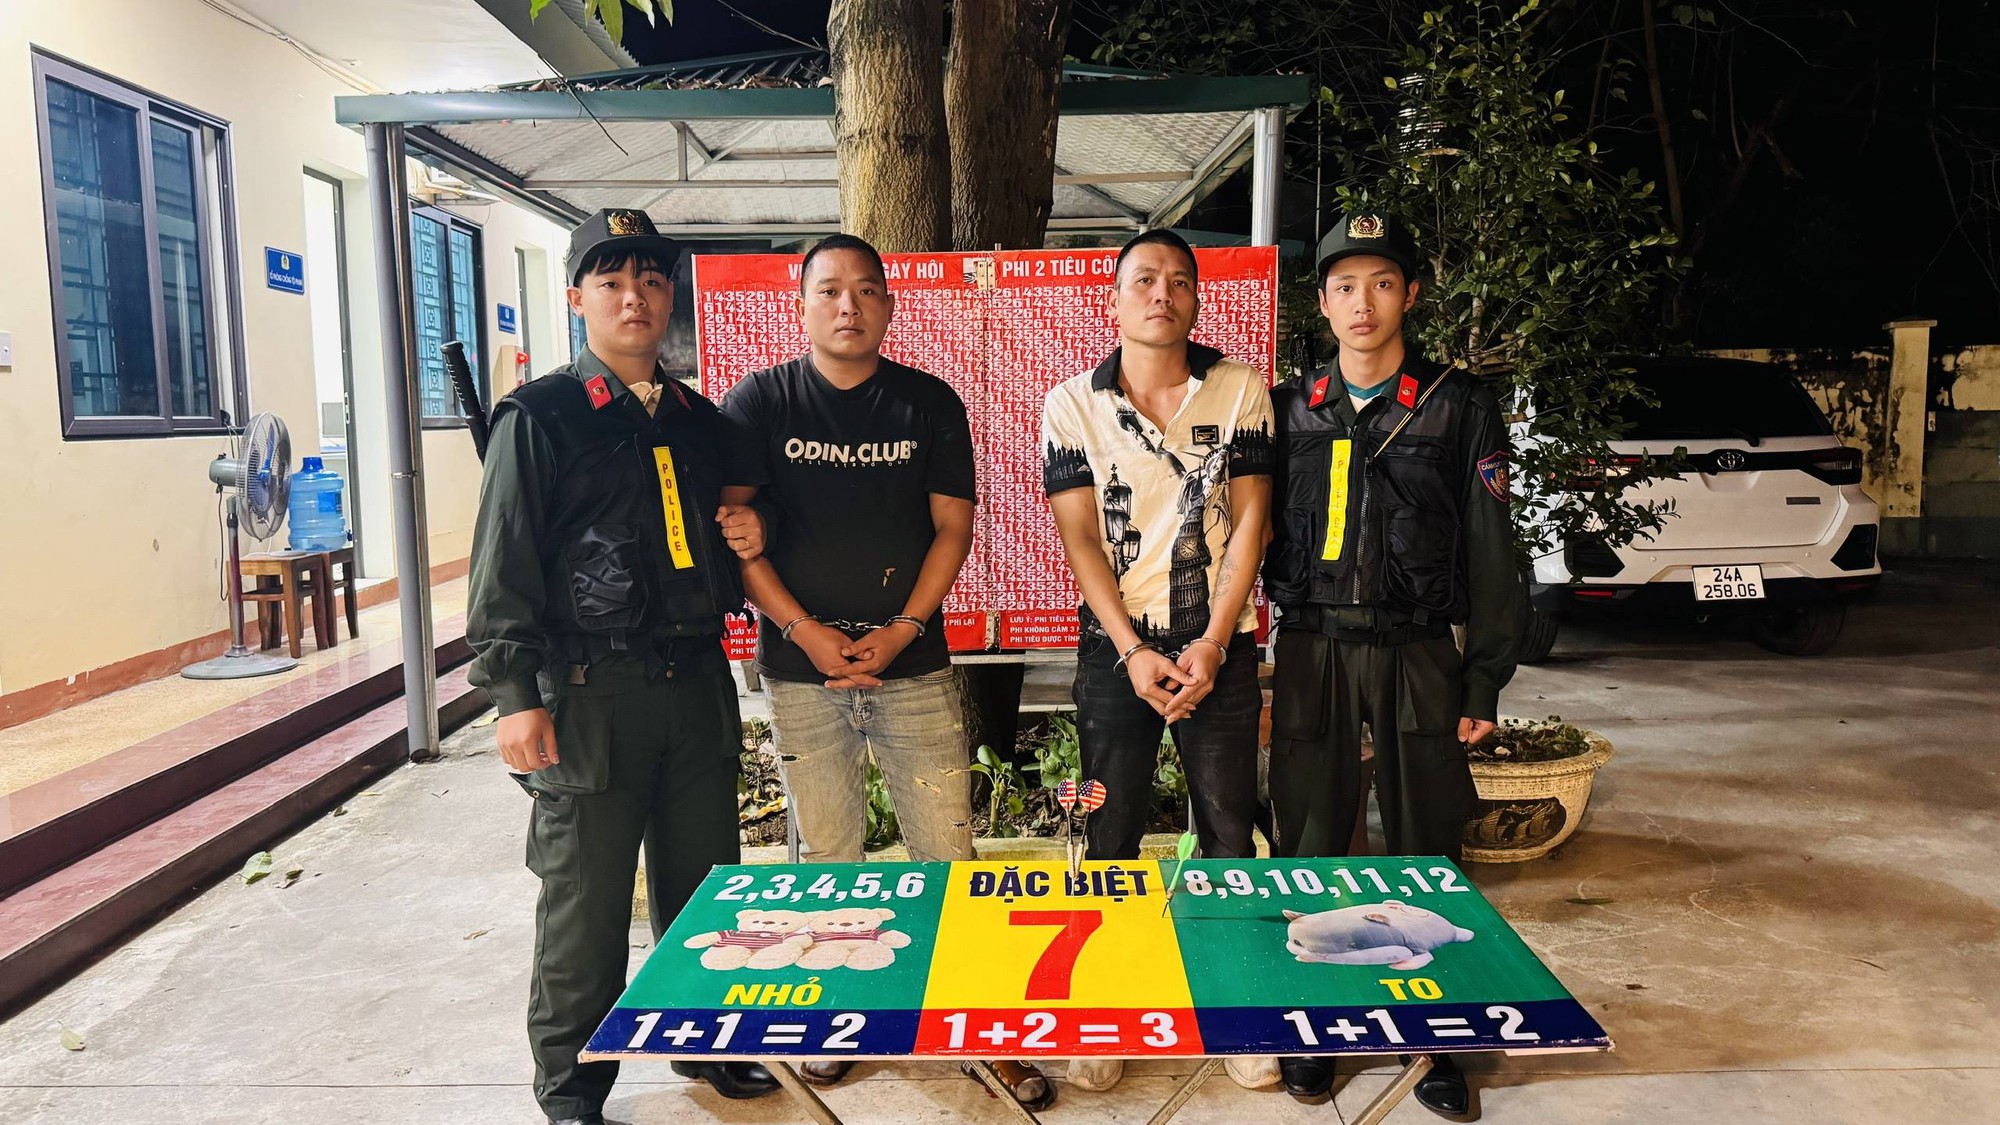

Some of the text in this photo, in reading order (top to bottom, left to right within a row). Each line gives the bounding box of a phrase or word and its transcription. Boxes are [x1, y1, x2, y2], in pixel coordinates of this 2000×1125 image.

[916, 259, 944, 282] HỘI
[1002, 260, 1029, 277] PHI
[1035, 260, 1045, 276] 2
[1050, 256, 1086, 276] TIÊU
[662, 463, 682, 552] POLICE
[1713, 568, 1743, 583] 24A
[1704, 583, 1757, 599] 258.06
[1024, 625, 1049, 633] KHÔNG
[1025, 635, 1040, 643] TIÊU
[969, 865, 1148, 903] ĐẶC BIỆT
[1008, 910, 1103, 1000] 7
[722, 976, 824, 1006] NHỎ
[1379, 977, 1444, 1001] TO
